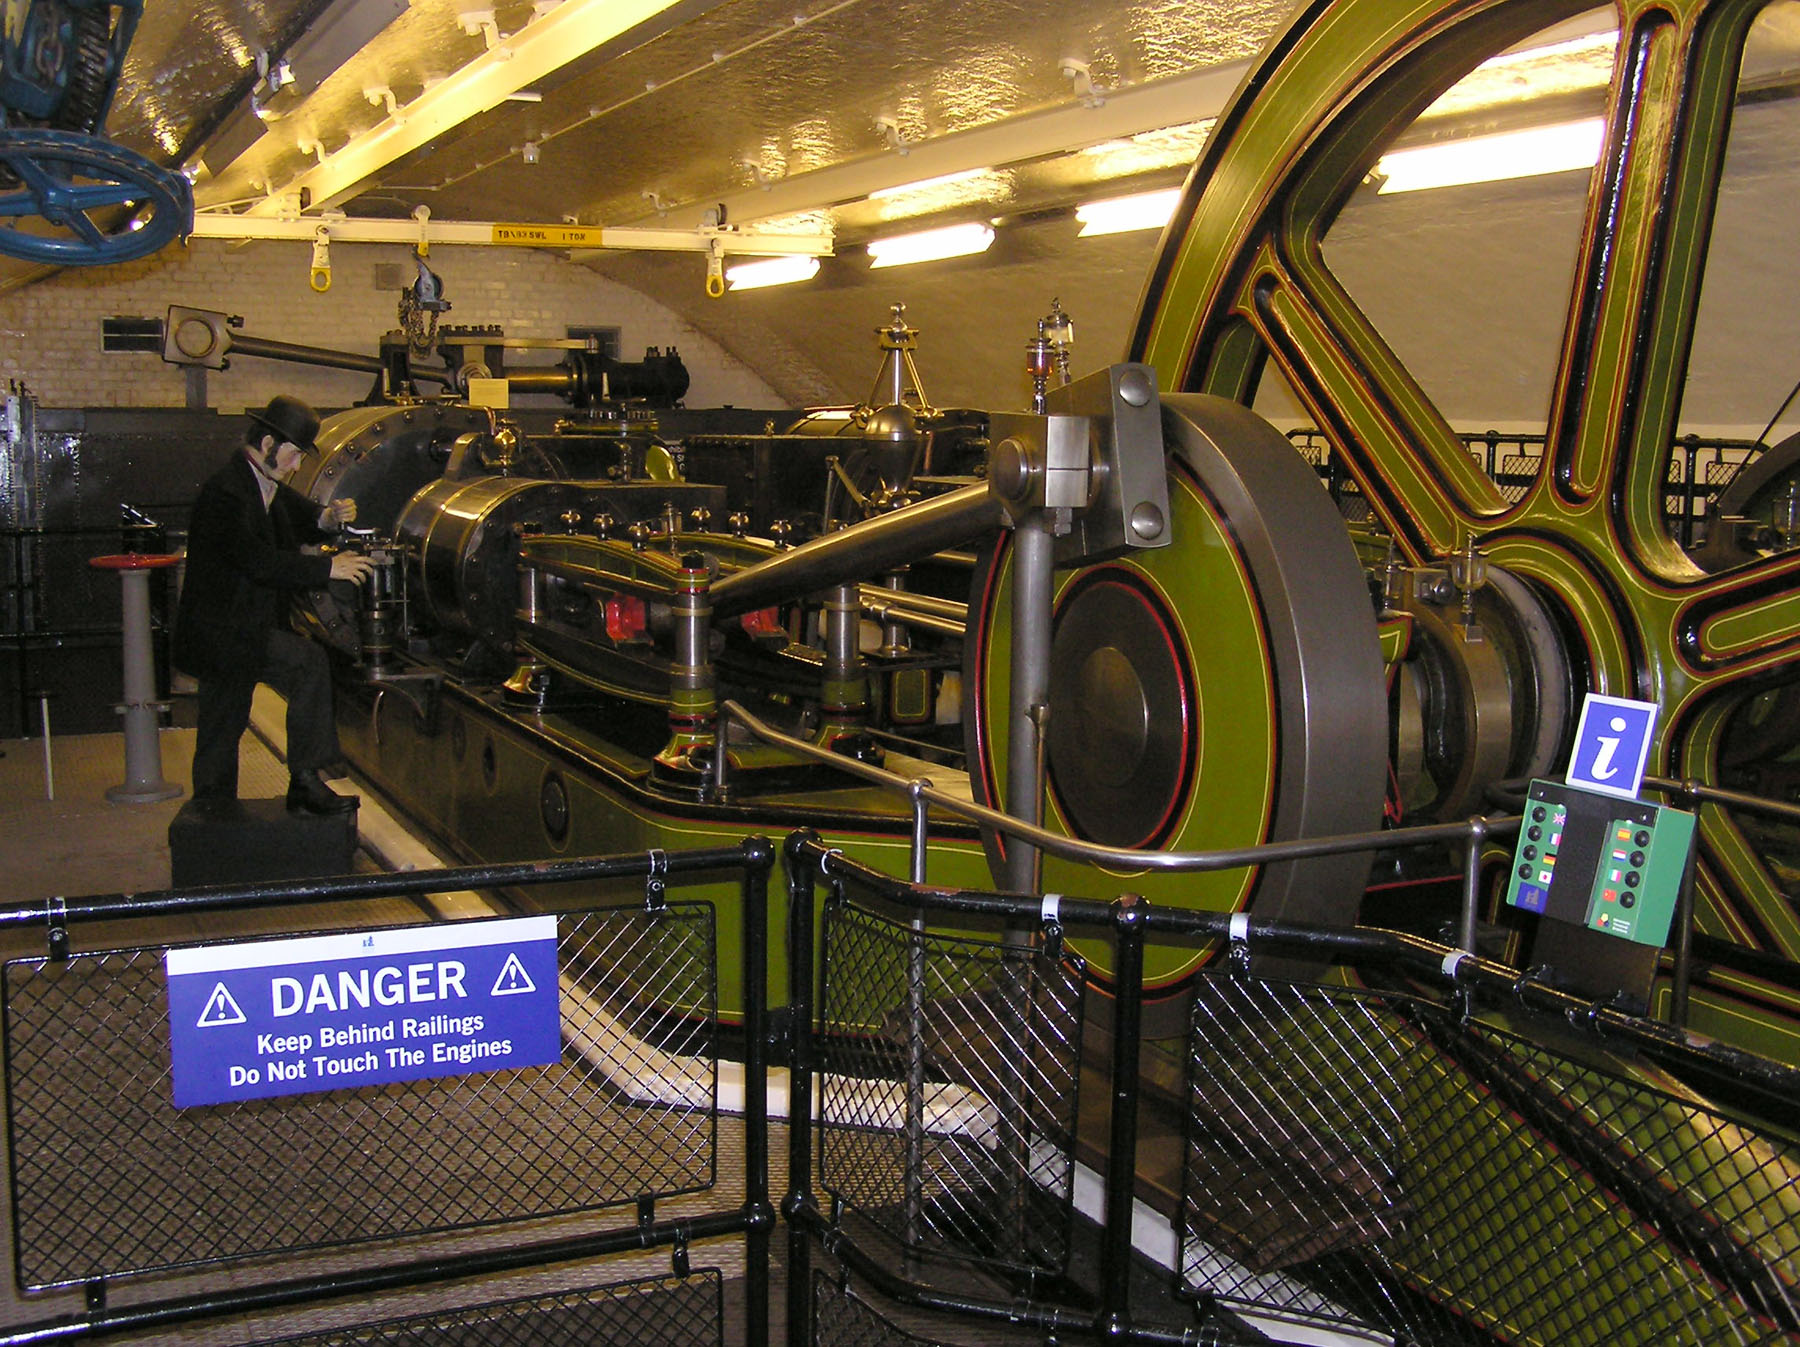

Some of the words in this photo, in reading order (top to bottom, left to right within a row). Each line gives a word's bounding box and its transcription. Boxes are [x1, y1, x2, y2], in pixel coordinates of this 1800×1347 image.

[271, 960, 468, 1018] DANGER
[257, 1033, 313, 1055] Keep
[319, 1020, 395, 1048] Behind
[402, 1014, 485, 1039] Railings
[229, 1065, 260, 1087] Do
[267, 1059, 307, 1083] Not
[312, 1049, 379, 1077] Touch
[384, 1046, 426, 1068] The
[432, 1038, 513, 1063] Engines
